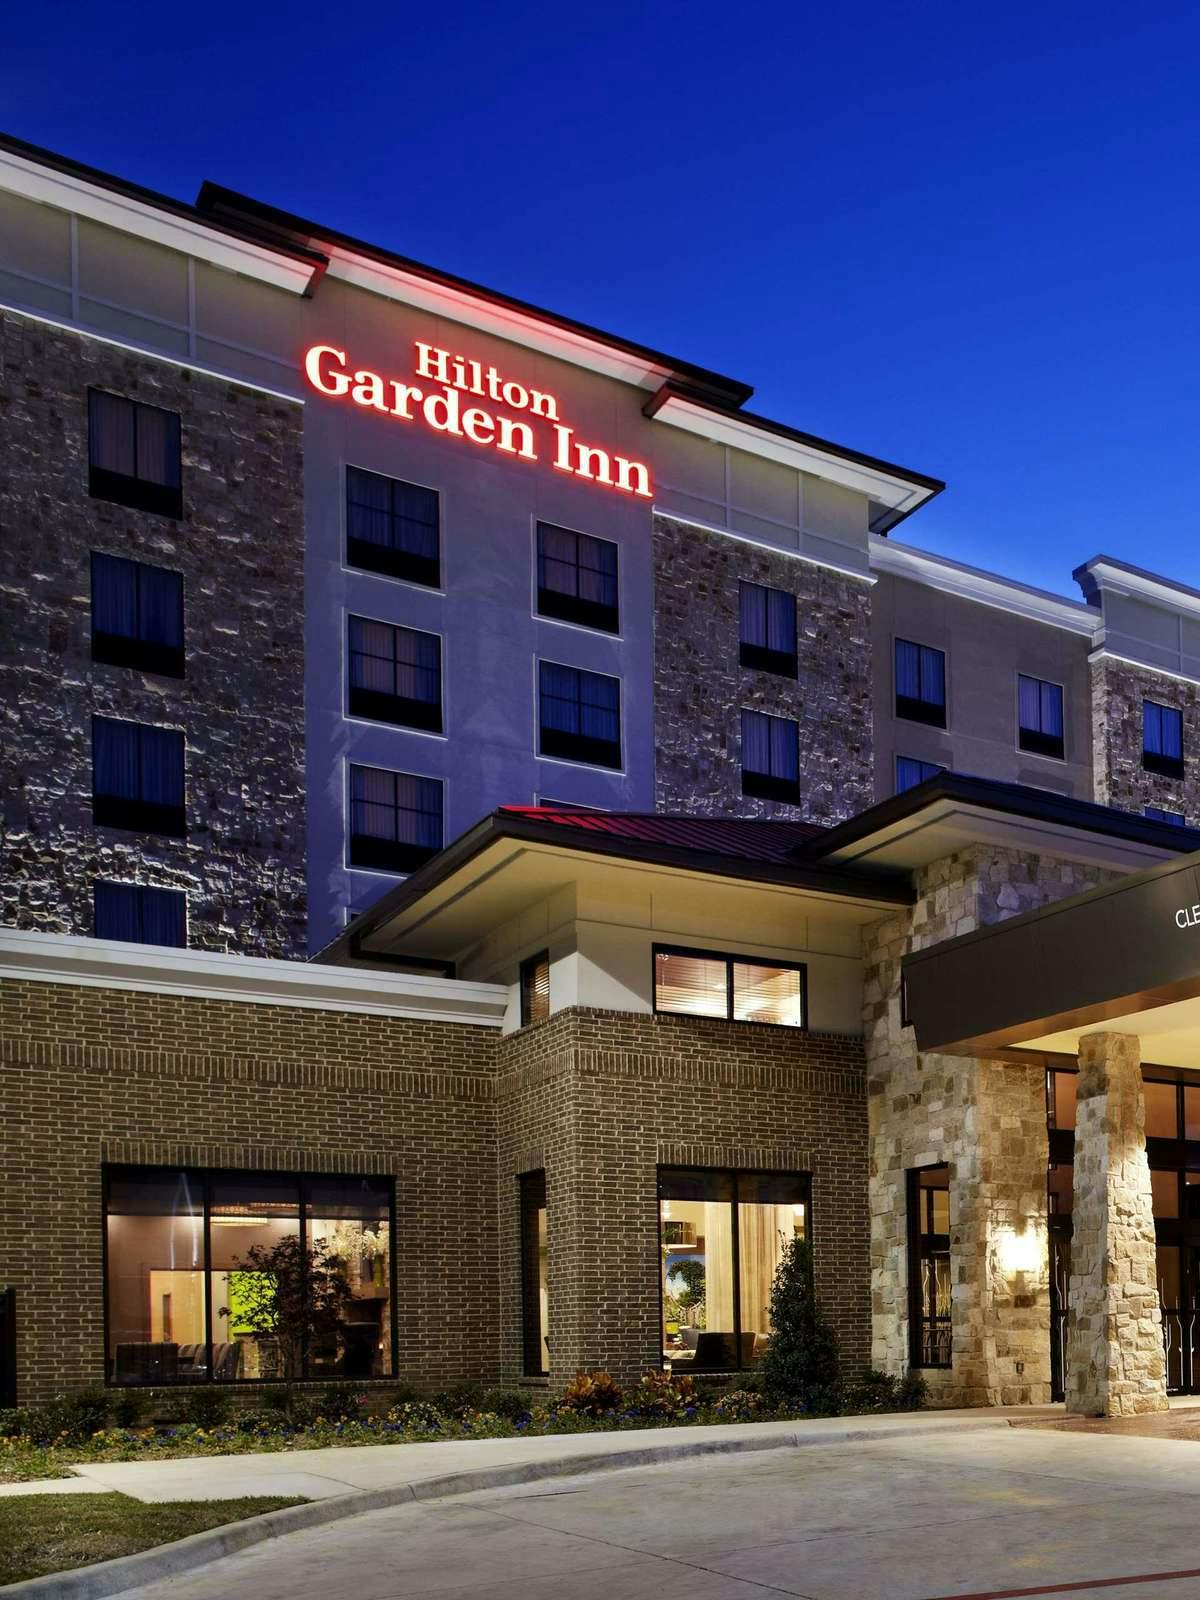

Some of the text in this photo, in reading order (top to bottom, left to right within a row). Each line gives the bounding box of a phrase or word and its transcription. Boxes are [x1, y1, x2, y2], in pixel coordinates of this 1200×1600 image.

[305, 345, 653, 497] Garden Inn
[413, 341, 559, 421] Hilton
